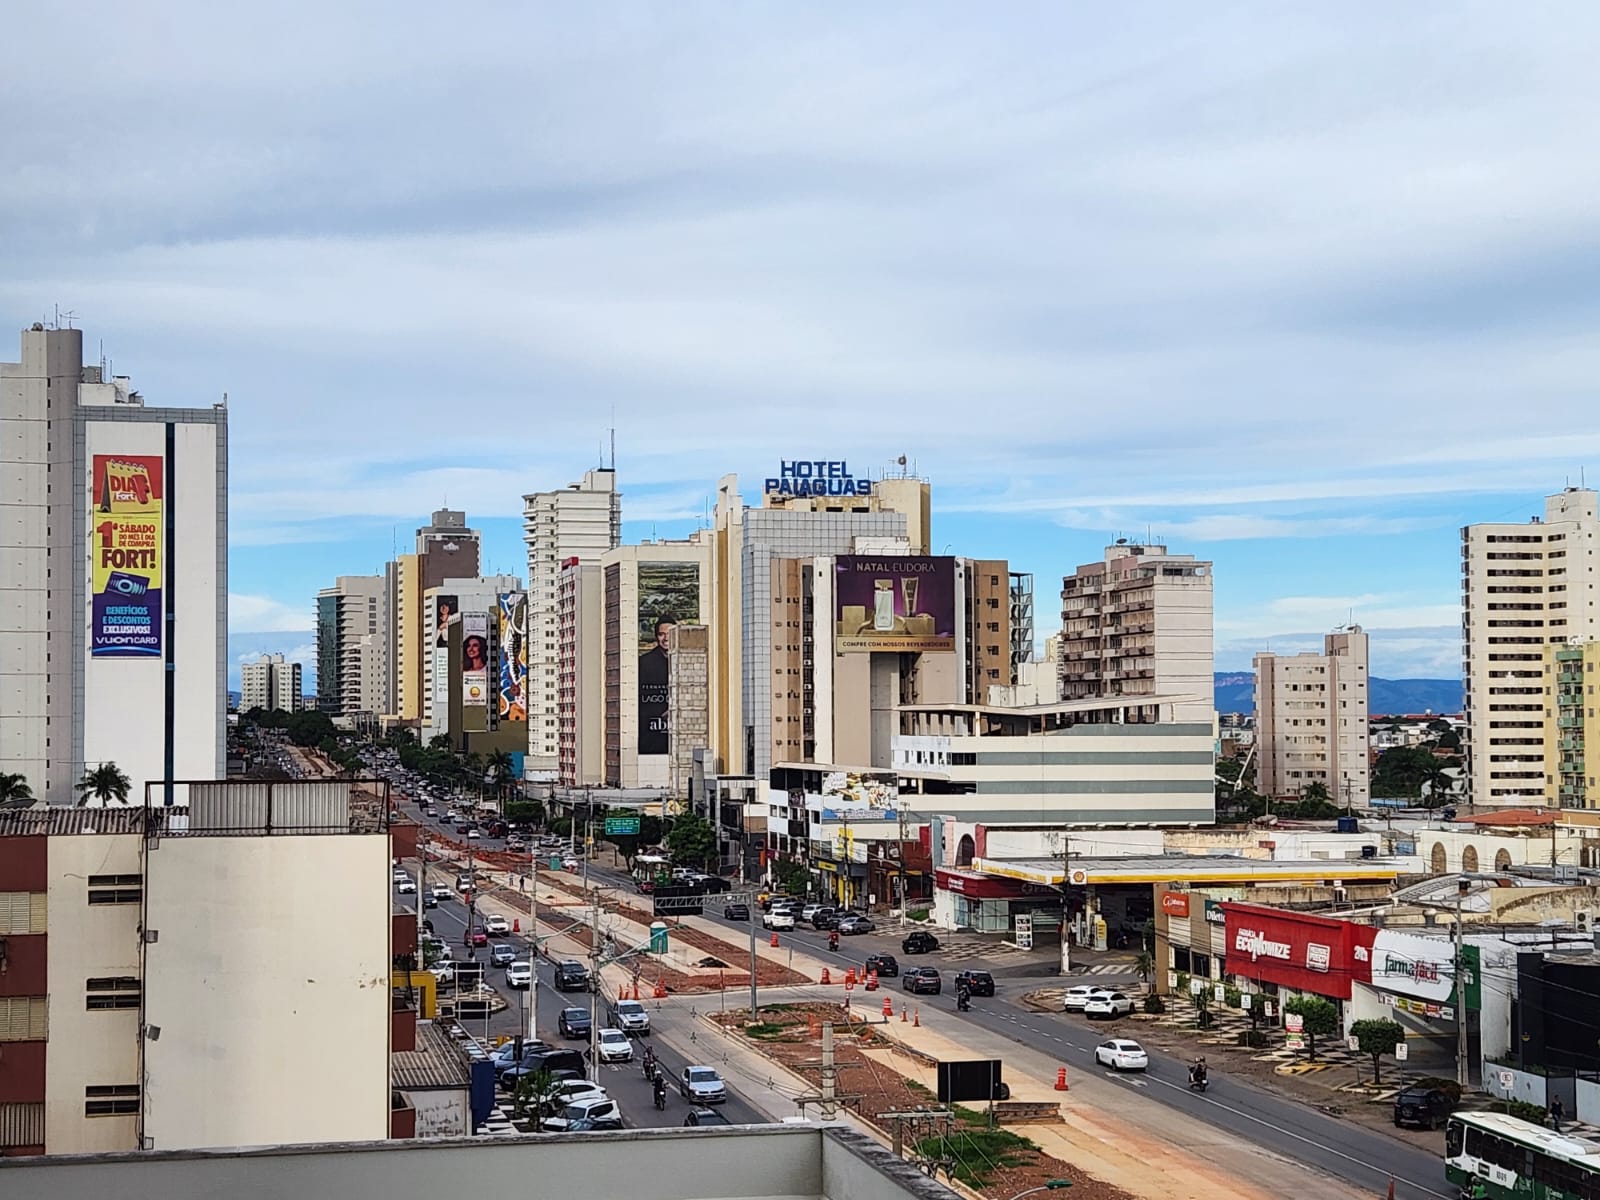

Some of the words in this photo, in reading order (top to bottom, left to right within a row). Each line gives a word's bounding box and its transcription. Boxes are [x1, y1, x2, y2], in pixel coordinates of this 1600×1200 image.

[781, 461, 853, 478] HOTEL
[765, 478, 872, 496] PAIAGUAS
[119, 522, 156, 534] SÁBADO
[102, 549, 156, 569] FORT!
[856, 563, 890, 572] NATAL
[892, 563, 936, 572] EUDORA
[108, 616, 152, 625] DESCONTOS
[641, 695, 665, 703] LAGO
